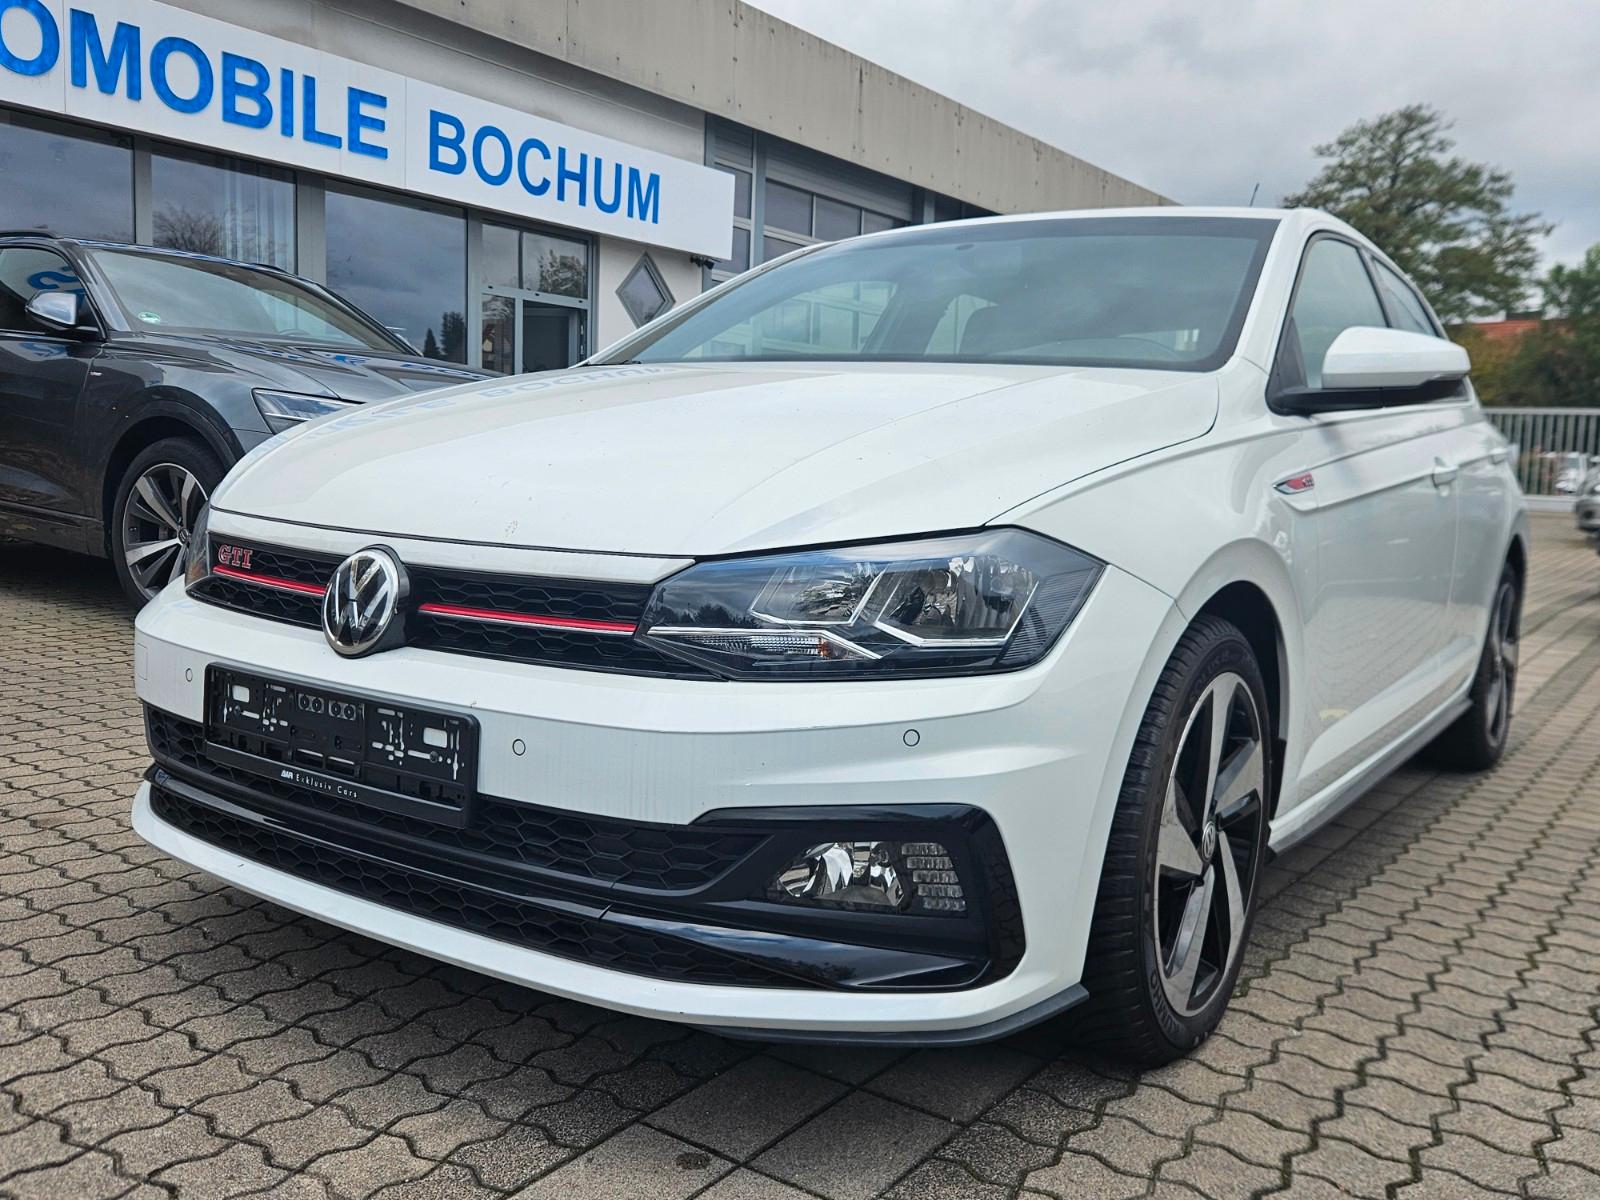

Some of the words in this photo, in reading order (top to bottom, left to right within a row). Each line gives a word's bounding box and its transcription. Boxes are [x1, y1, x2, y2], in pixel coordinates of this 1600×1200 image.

[0, 0, 388, 160] OMOBILE
[428, 109, 661, 225] BOCHUM
[217, 544, 253, 570] GTI
[295, 773, 331, 791] Exklusiv
[337, 785, 357, 798] Cars
